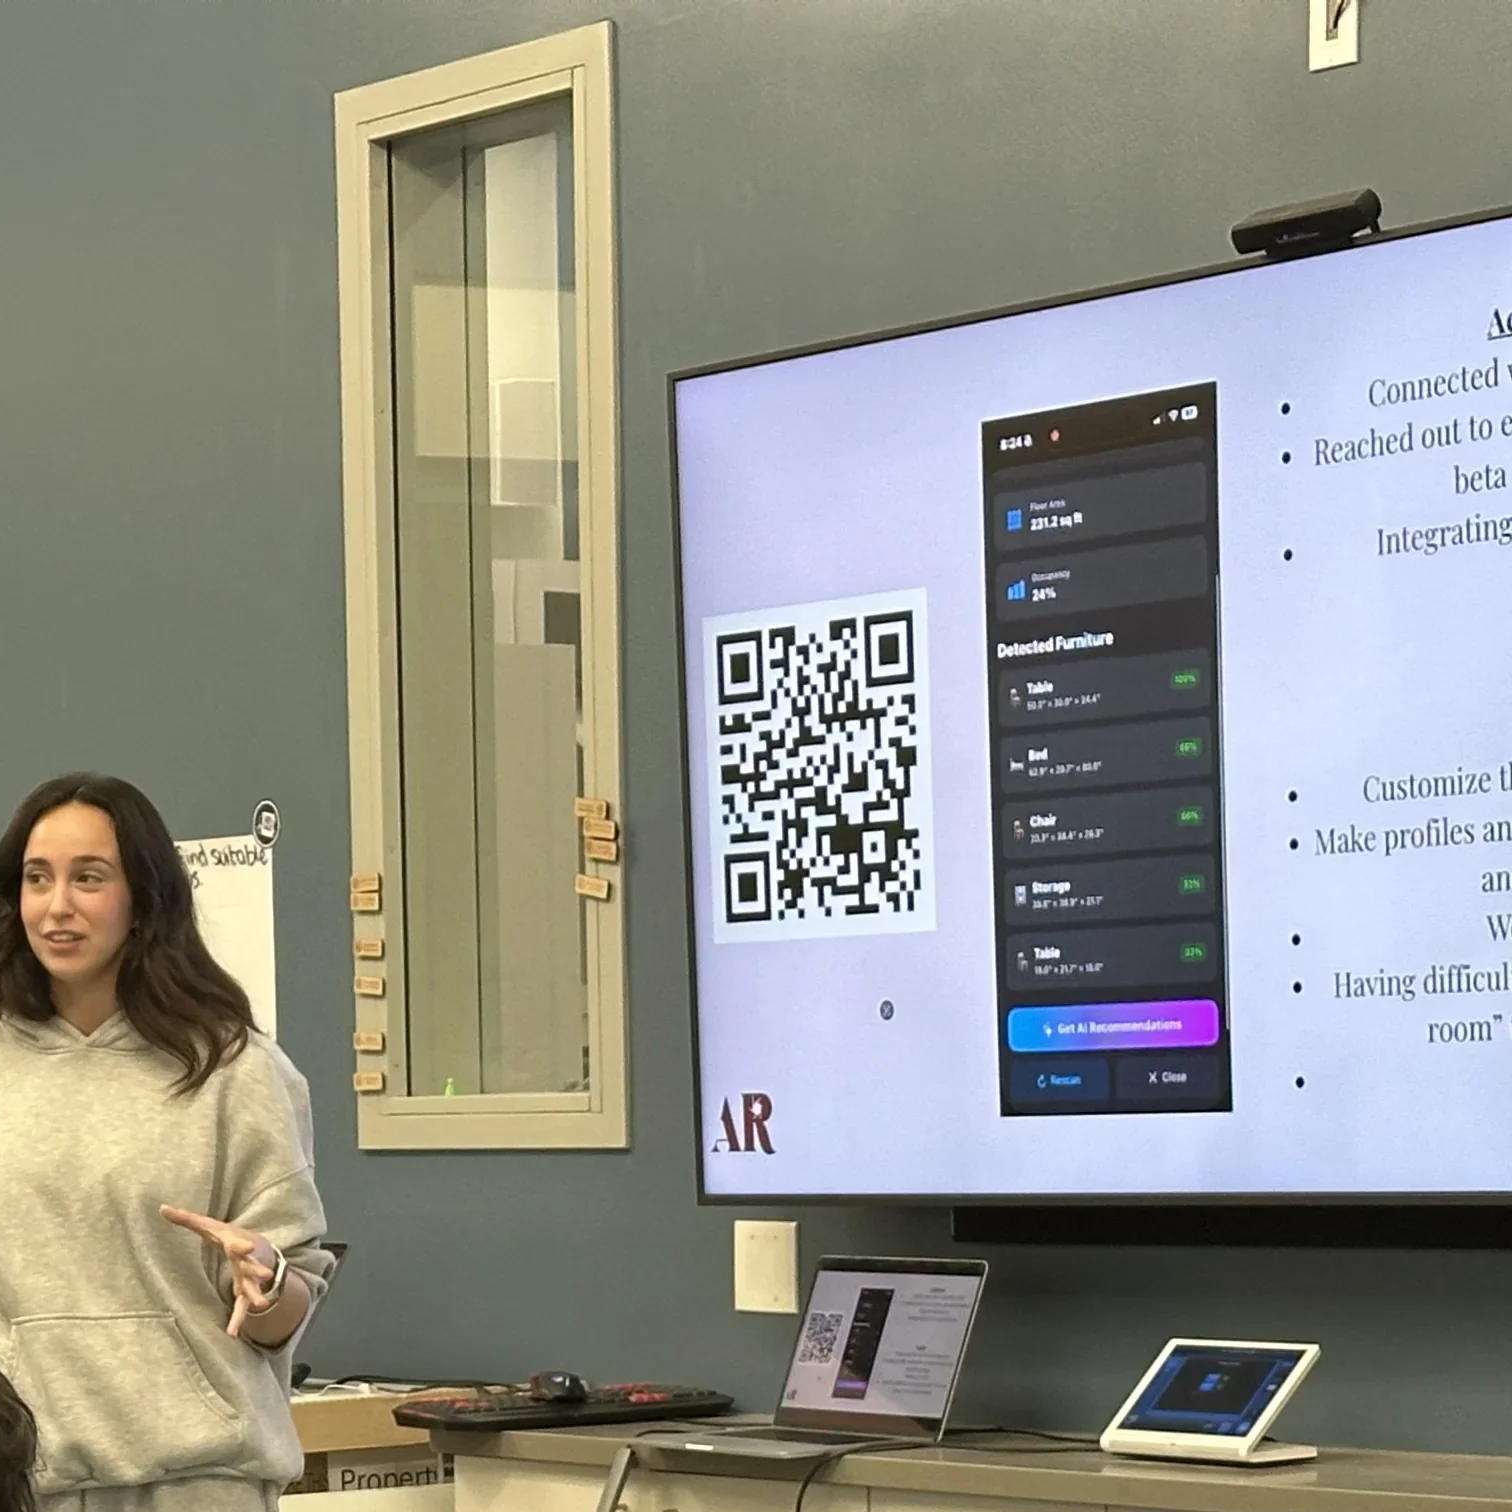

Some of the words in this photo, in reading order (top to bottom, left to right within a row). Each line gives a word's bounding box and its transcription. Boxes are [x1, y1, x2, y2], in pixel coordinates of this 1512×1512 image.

[1369, 357, 1499, 407] Connected
[1314, 423, 1414, 466] Reached
[1421, 418, 1462, 449] out
[1470, 415, 1493, 441] to
[1454, 464, 1506, 494] beta
[1377, 513, 1512, 556] Integrating
[997, 637, 1053, 659] Detected
[1055, 628, 1113, 652] Furniture
[1026, 680, 1053, 695] Table
[1028, 748, 1048, 762] Bed
[1363, 766, 1492, 803] Customize
[1029, 813, 1056, 828] Chair
[1314, 824, 1376, 856] Make
[1384, 817, 1475, 857] profiles
[1032, 879, 1070, 895] Storage
[1486, 913, 1512, 942] W
[1033, 946, 1060, 960] Table
[1333, 968, 1416, 1002] Having
[1423, 961, 1512, 995] difficul
[1058, 1023, 1074, 1034] Get
[1089, 1018, 1182, 1034] Recommendations
[1427, 1013, 1502, 1043] room”
[1162, 1071, 1187, 1083] Close
[710, 1092, 776, 1155] AR
